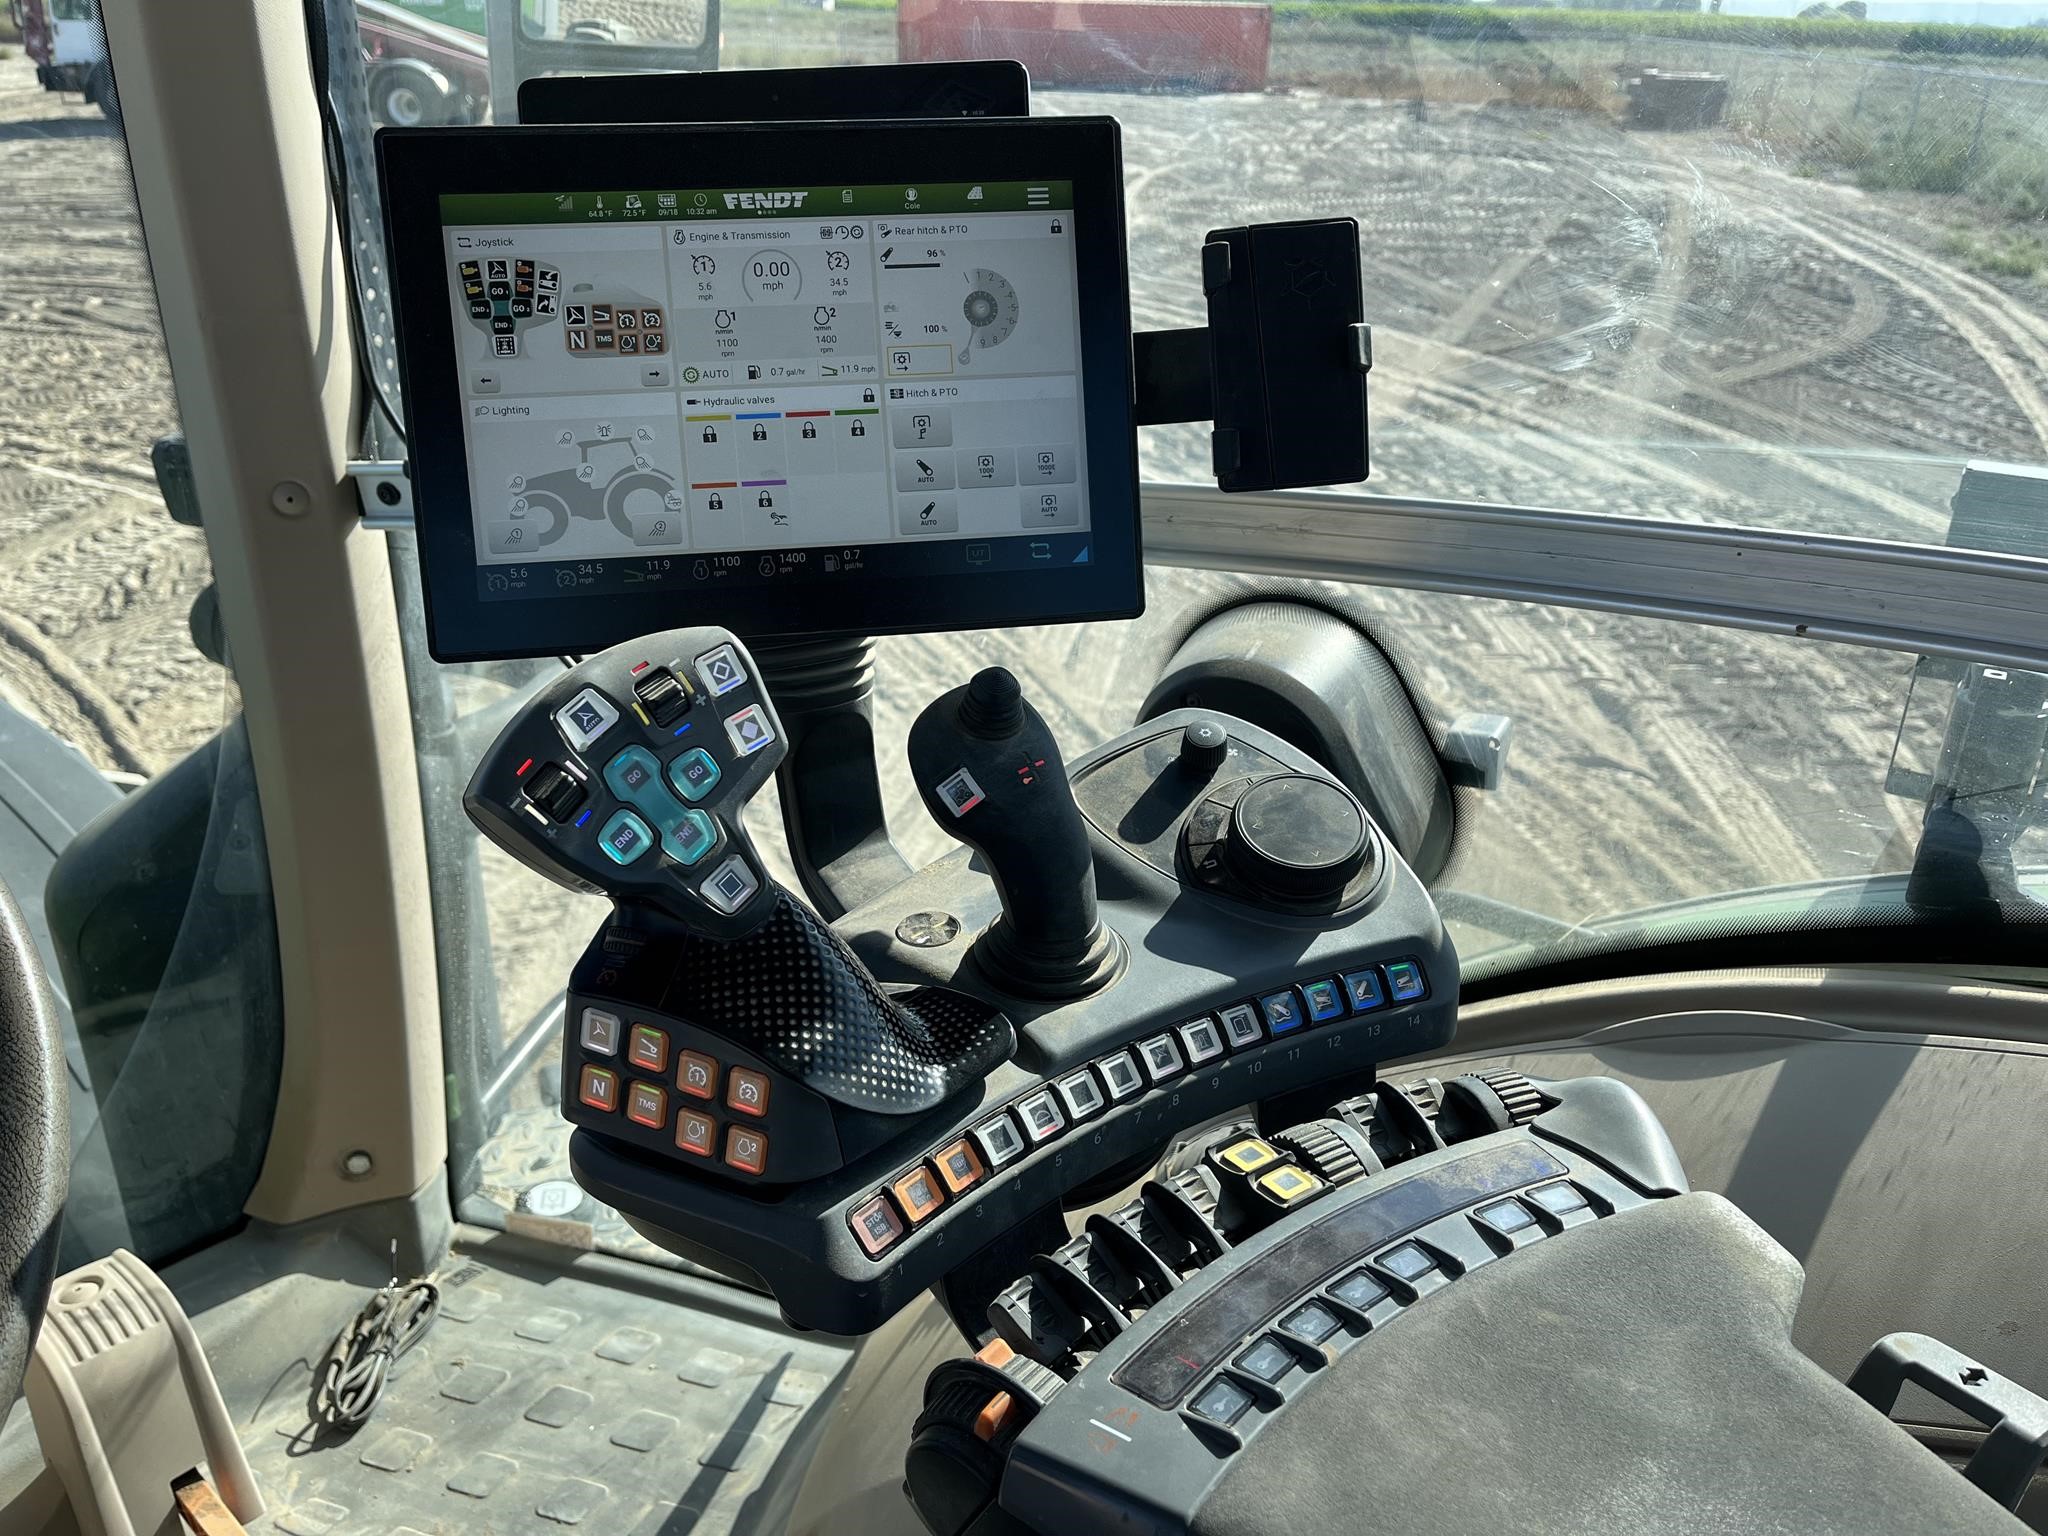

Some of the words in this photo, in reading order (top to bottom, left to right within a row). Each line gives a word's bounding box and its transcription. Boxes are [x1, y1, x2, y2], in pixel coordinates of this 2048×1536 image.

[723, 191, 808, 210] FENDT
[904, 202, 921, 210] Cole
[622, 209, 638, 217] 72.5
[658, 208, 678, 217] 09/18
[686, 208, 705, 216] 10:32
[895, 226, 915, 236] Rear
[916, 225, 939, 235] hitch
[940, 225, 947, 235] &
[949, 225, 968, 234] PTO
[689, 231, 721, 243] Engine
[722, 231, 729, 240] &
[731, 230, 791, 241] Transmission
[475, 237, 514, 248] Joystick
[926, 249, 938, 258] 96
[834, 257, 843, 267] 2
[753, 261, 790, 278] 0.00
[698, 282, 712, 291] 5.6
[762, 280, 784, 292] mph
[830, 278, 849, 286] 34.5
[491, 287, 504, 295] GO
[833, 289, 848, 297] mph
[698, 294, 714, 302] mph
[731, 312, 736, 321] 1
[829, 308, 837, 317] 2
[649, 317, 656, 325] 2
[923, 325, 940, 333] 100
[570, 332, 585, 349] N
[596, 335, 612, 343] TMS
[716, 338, 739, 348] 1100
[815, 335, 838, 344] 1400
[721, 350, 735, 358] rpm
[820, 346, 834, 354] rpm
[702, 369, 729, 379] AUTO
[770, 367, 784, 377] 0.7
[841, 365, 859, 373] 11.9
[860, 366, 876, 374] mph
[906, 388, 930, 398] Hitch
[931, 388, 938, 397] &
[939, 387, 958, 396] PTO
[703, 396, 745, 407] Hydraulic
[746, 396, 775, 405] valves
[492, 405, 530, 417] Lighting
[757, 432, 763, 440] 2
[806, 430, 812, 438] 3
[854, 428, 861, 436] 4
[707, 434, 712, 442] 1
[713, 501, 719, 509] 5
[762, 499, 769, 507] 6
[779, 552, 806, 563] 1400
[843, 549, 860, 560] 0.7
[646, 560, 670, 571] 11.9
[713, 556, 741, 567] 1100
[510, 568, 528, 579] 5.6
[578, 563, 603, 574] 34.5
[780, 566, 793, 574] rpm
[579, 576, 595, 584] mph
[647, 573, 662, 581] mph
[511, 580, 526, 588] mph
[627, 769, 642, 784] GO
[688, 765, 704, 781] GO
[614, 828, 634, 849] END
[674, 824, 694, 844] END
[1407, 1013, 1421, 1027] 14
[1367, 1023, 1382, 1037] 13
[1327, 1034, 1342, 1049] 12
[1286, 1048, 1301, 1062] 11
[1247, 1060, 1263, 1075] 10
[1211, 1076, 1220, 1089] 9
[592, 1079, 604, 1097] N
[638, 1097, 657, 1111] TMS
[700, 1125, 705, 1135] 1
[1094, 1132, 1101, 1145] 6
[751, 1143, 757, 1152] 2
[1055, 1154, 1063, 1167] 5
[975, 1204, 983, 1218] 3
[936, 1233, 945, 1246] 2
